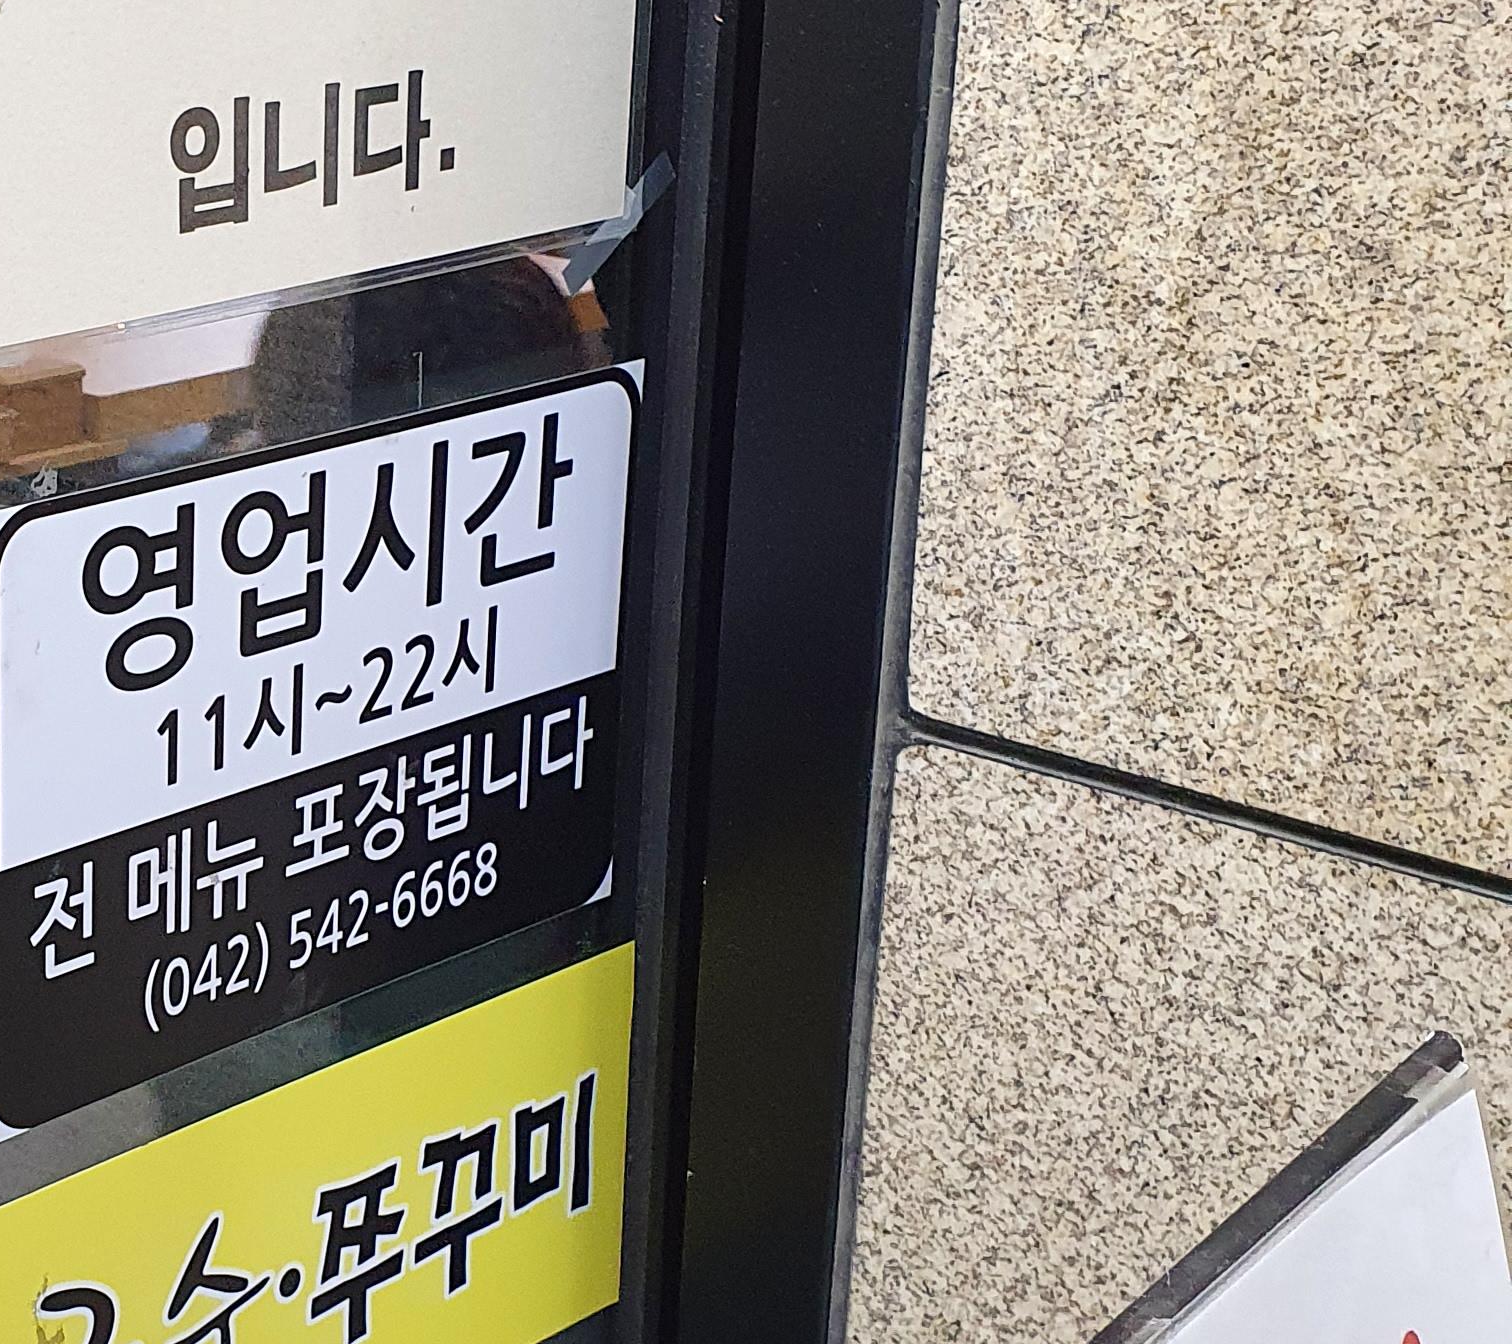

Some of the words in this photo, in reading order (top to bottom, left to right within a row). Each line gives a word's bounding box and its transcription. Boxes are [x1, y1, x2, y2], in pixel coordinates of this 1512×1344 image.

[170, 70, 455, 234] 입니다.
[82, 413, 573, 691] 영업시간
[158, 606, 498, 786] 11시~22시
[30, 860, 93, 980] 전
[128, 821, 264, 934] 메뉴
[285, 696, 593, 879] 포장됩니다
[145, 921, 269, 1032] (042)
[289, 844, 498, 971] 542-6668
